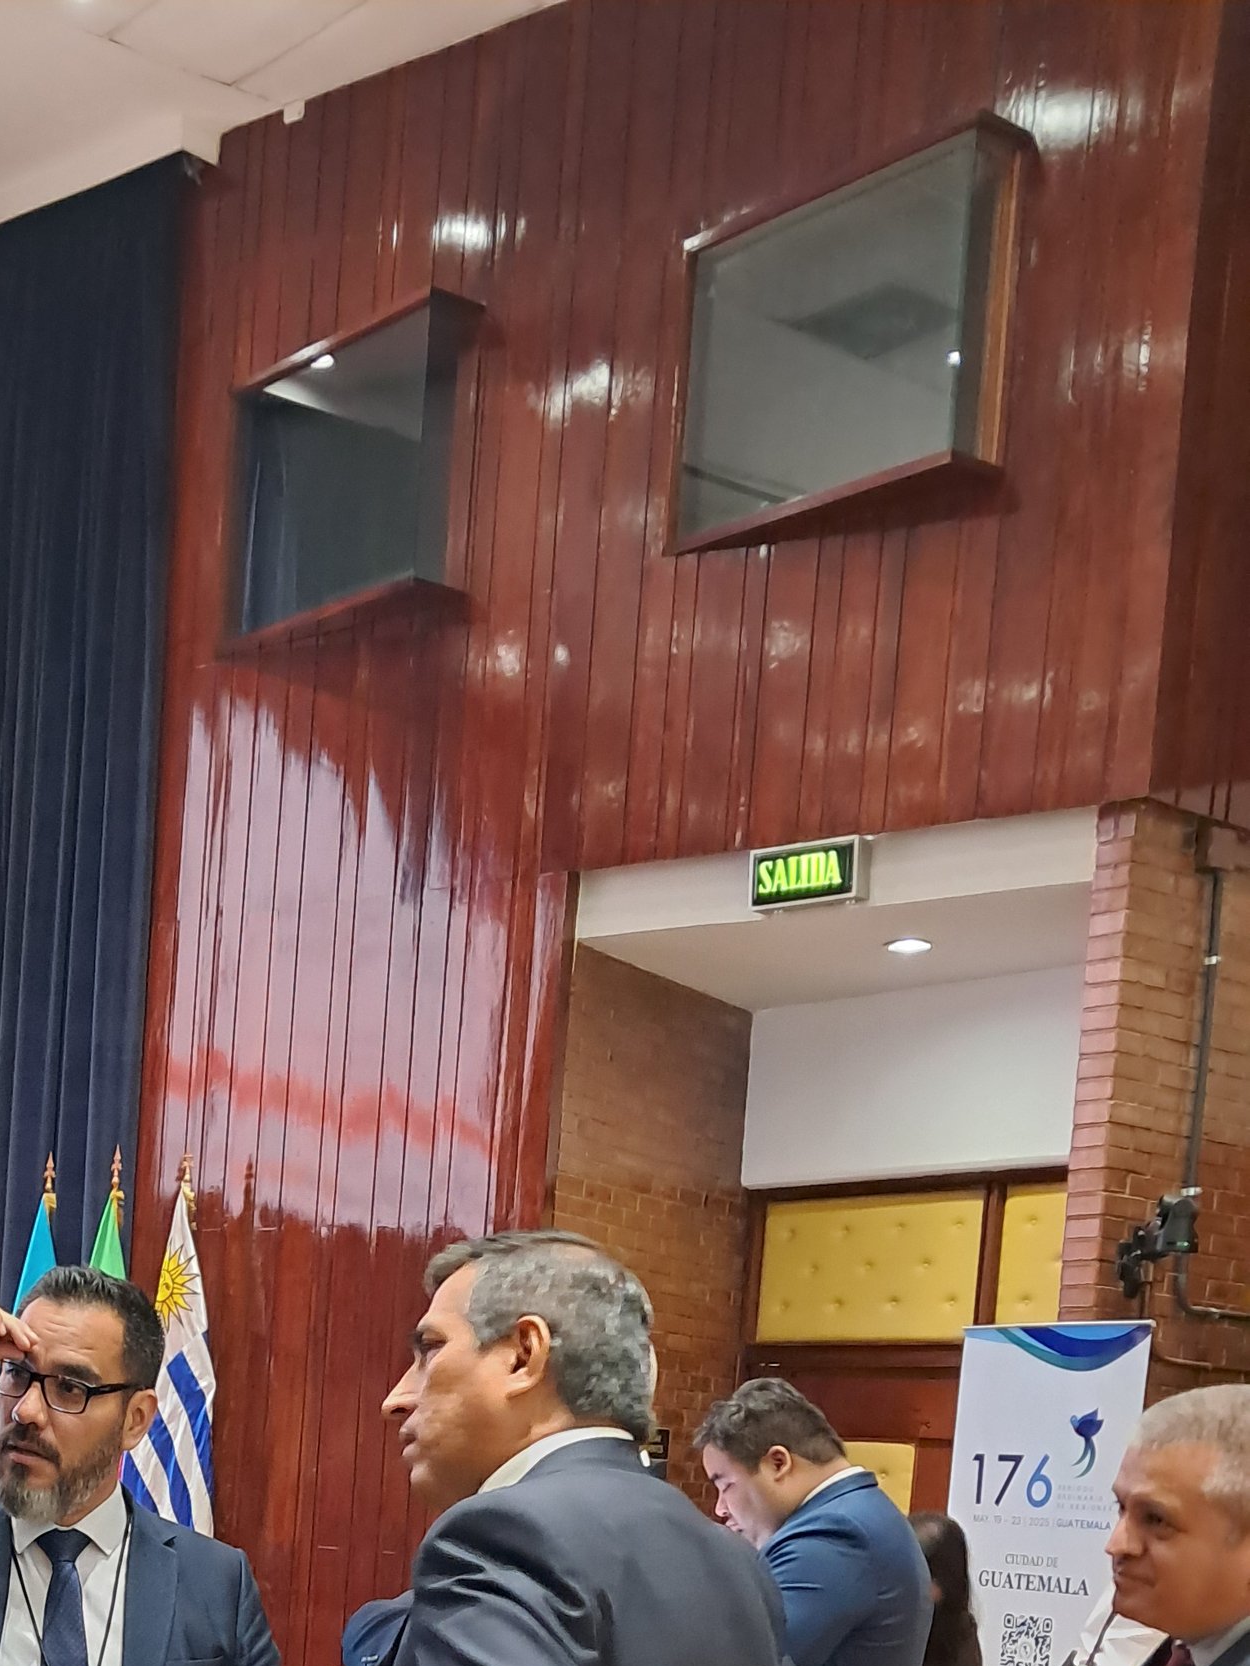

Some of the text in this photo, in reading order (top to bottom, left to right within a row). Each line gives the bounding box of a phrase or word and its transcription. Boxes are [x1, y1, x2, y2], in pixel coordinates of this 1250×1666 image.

[758, 849, 843, 894] SALIDA
[972, 1453, 1053, 1508] 176
[1056, 1518, 1112, 1531] GUATEMALA
[1005, 1553, 1059, 1568] CIUDAD DE
[978, 1569, 1090, 1597] GUATEMALA
